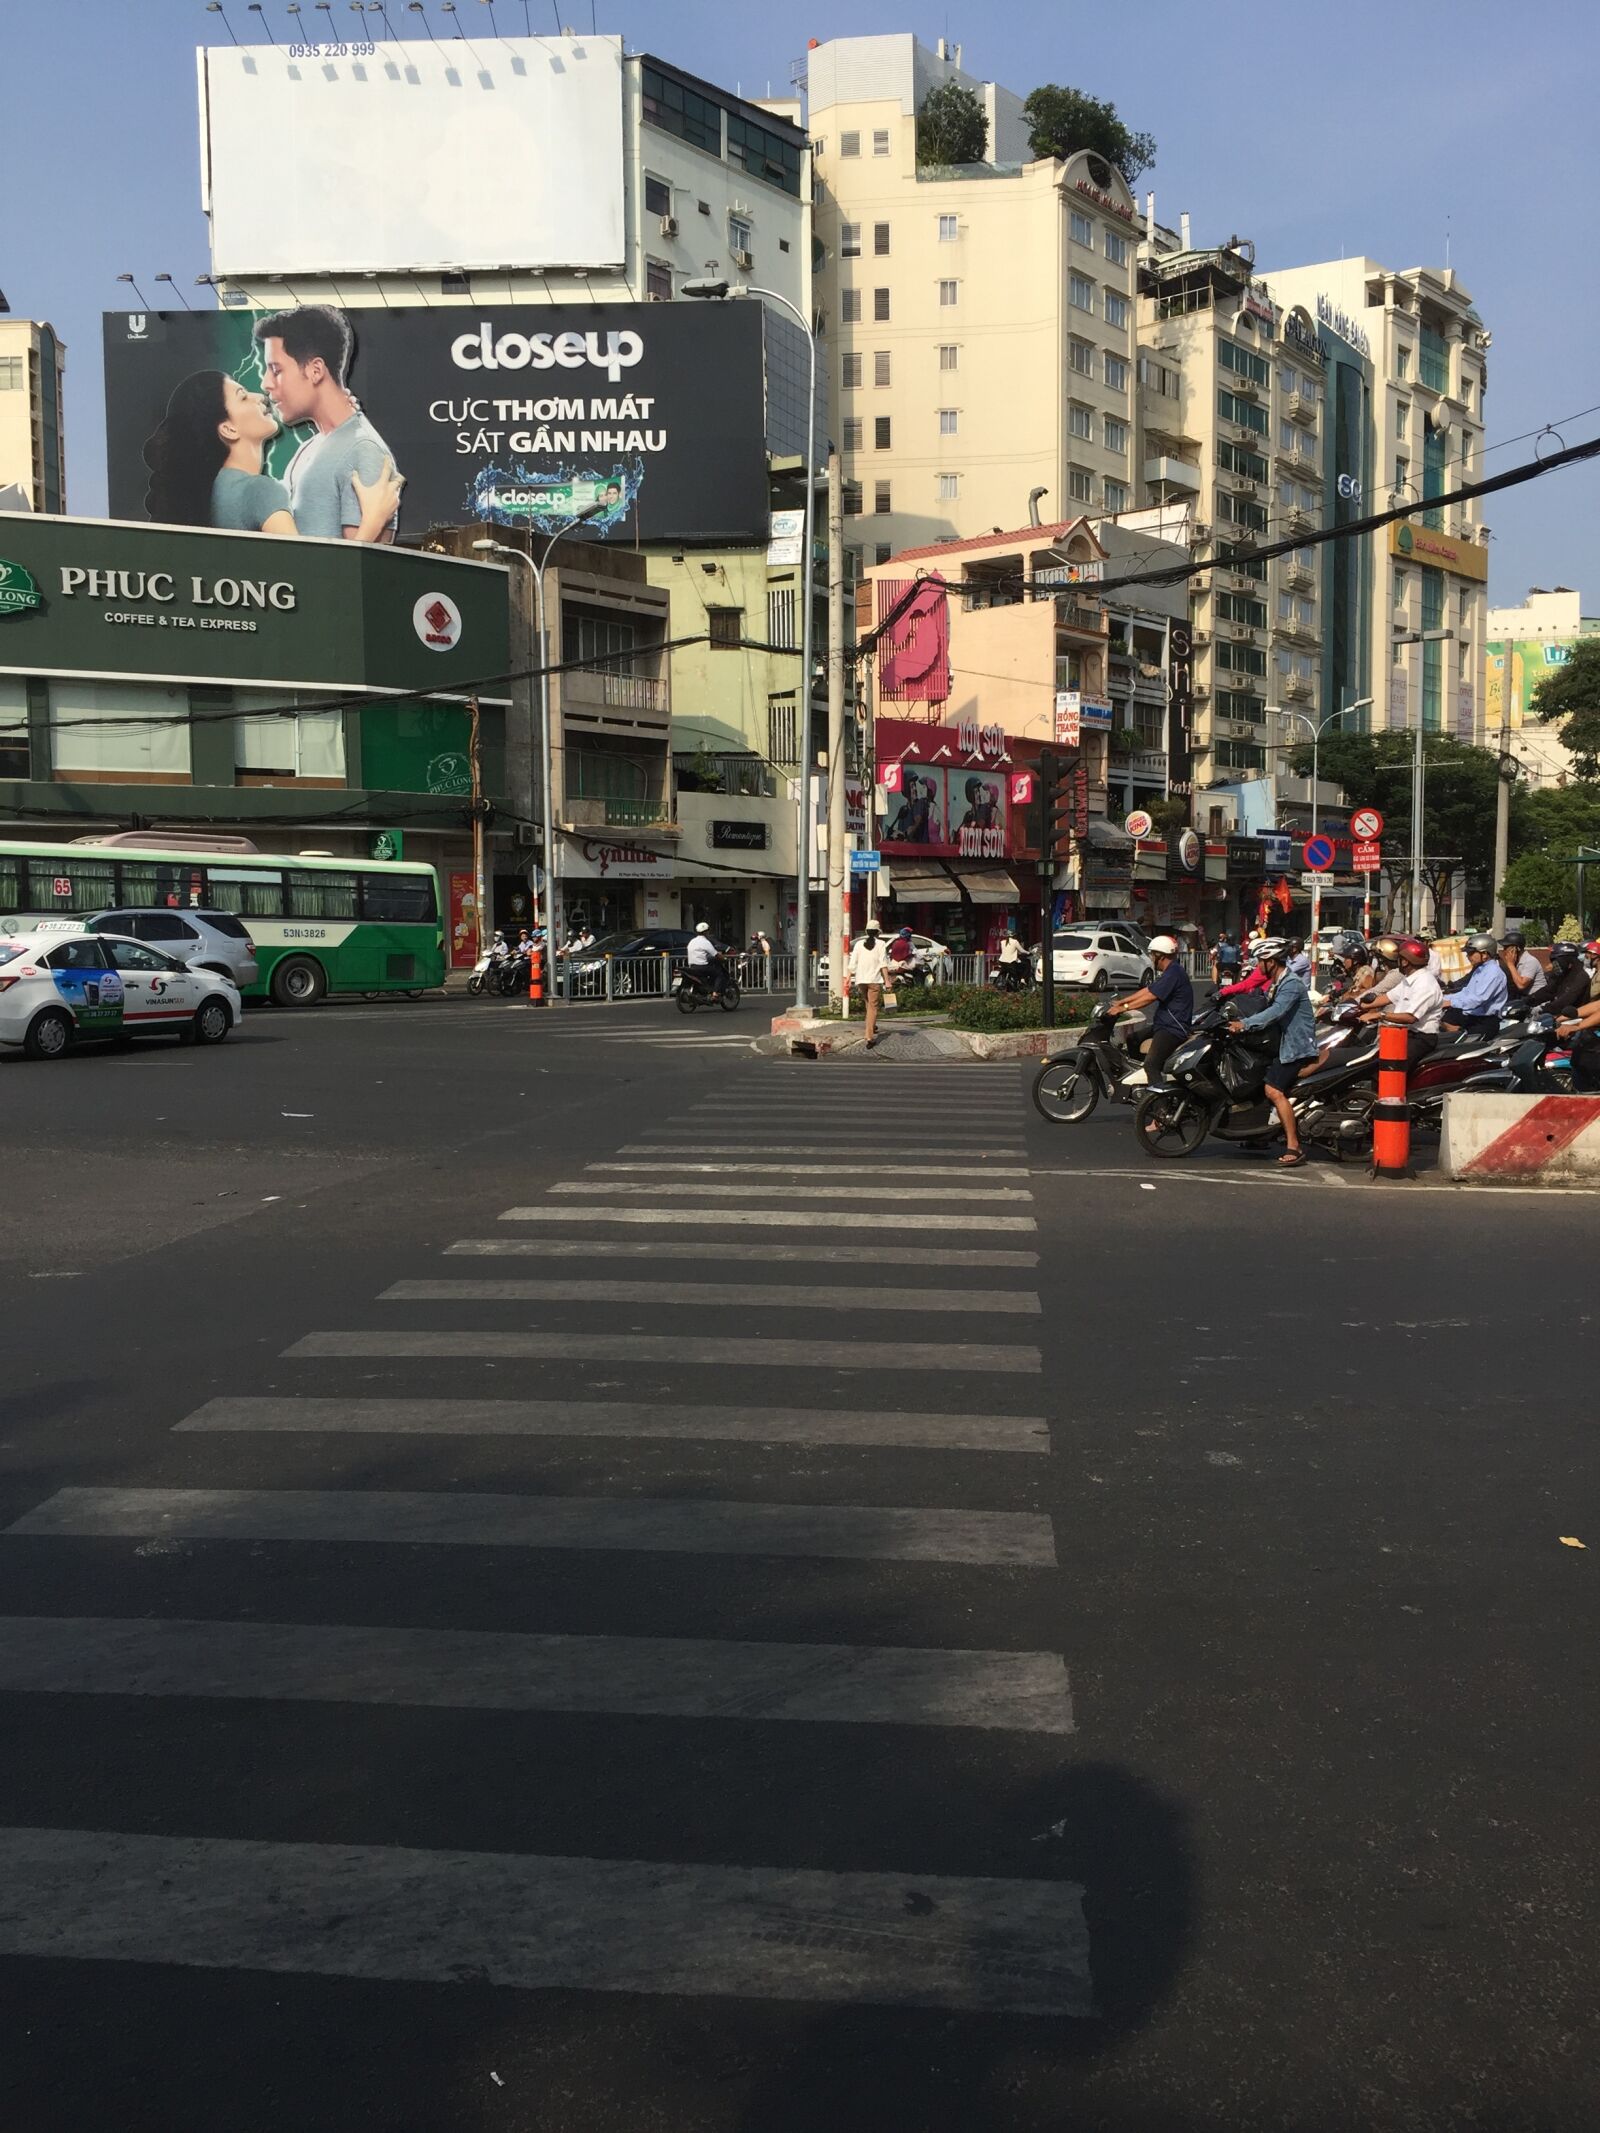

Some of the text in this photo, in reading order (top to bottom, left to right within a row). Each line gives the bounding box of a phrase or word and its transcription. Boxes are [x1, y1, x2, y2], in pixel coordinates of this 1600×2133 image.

[289, 42, 376, 57] 0935 220 999
[451, 322, 644, 382] closeup
[429, 394, 654, 426] CỰC THƠM MÁT
[456, 424, 666, 454] SÁT GẦN NHAU
[502, 489, 565, 511] closeup
[60, 566, 296, 610] PHUC LONG
[104, 612, 257, 631] COFFEE & TEA EXPRESS
[1130, 820, 1148, 833] KING
[56, 880, 70, 894] 65
